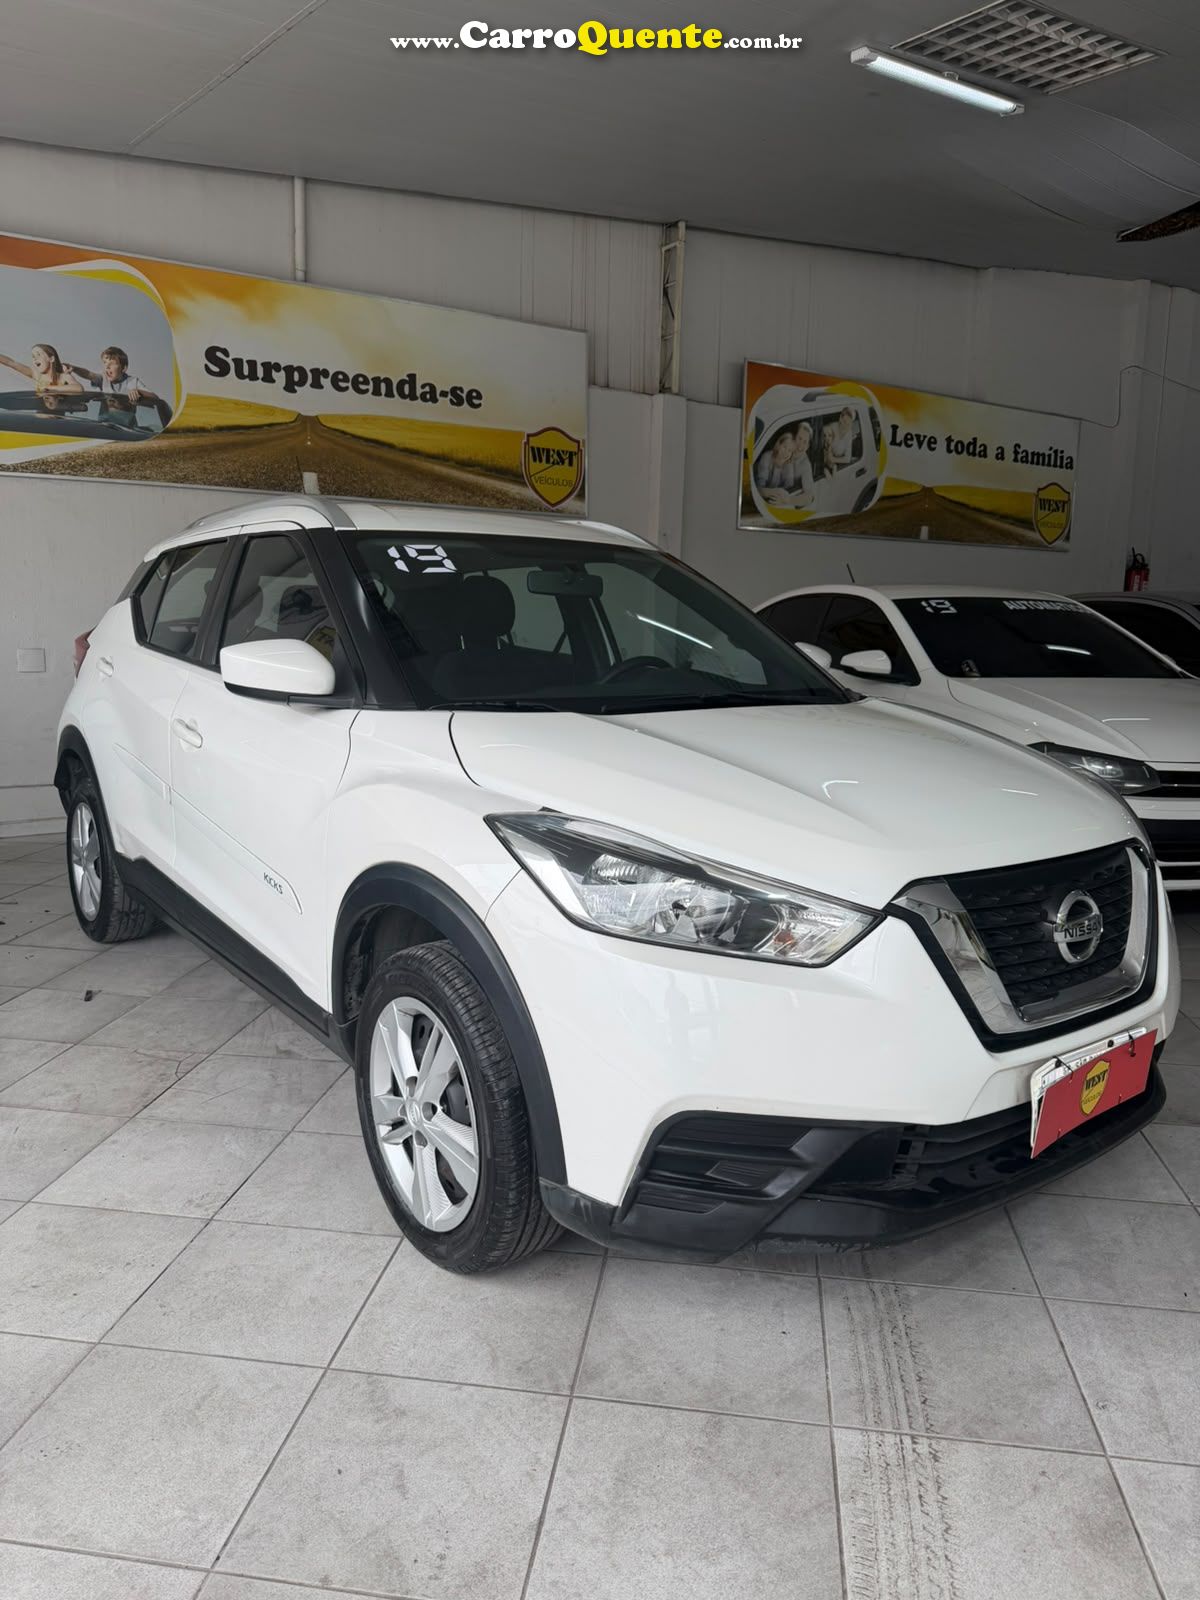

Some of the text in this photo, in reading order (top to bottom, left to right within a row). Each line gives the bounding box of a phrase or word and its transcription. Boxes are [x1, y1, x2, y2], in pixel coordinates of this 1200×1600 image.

[204, 345, 483, 409] Surpreenda-se
[530, 446, 578, 467] WEST
[889, 424, 1074, 470] Leve toda a família
[1039, 498, 1068, 513] WEST
[387, 544, 458, 573] 19
[921, 599, 958, 614] 19
[1085, 1068, 1108, 1091] WEST
